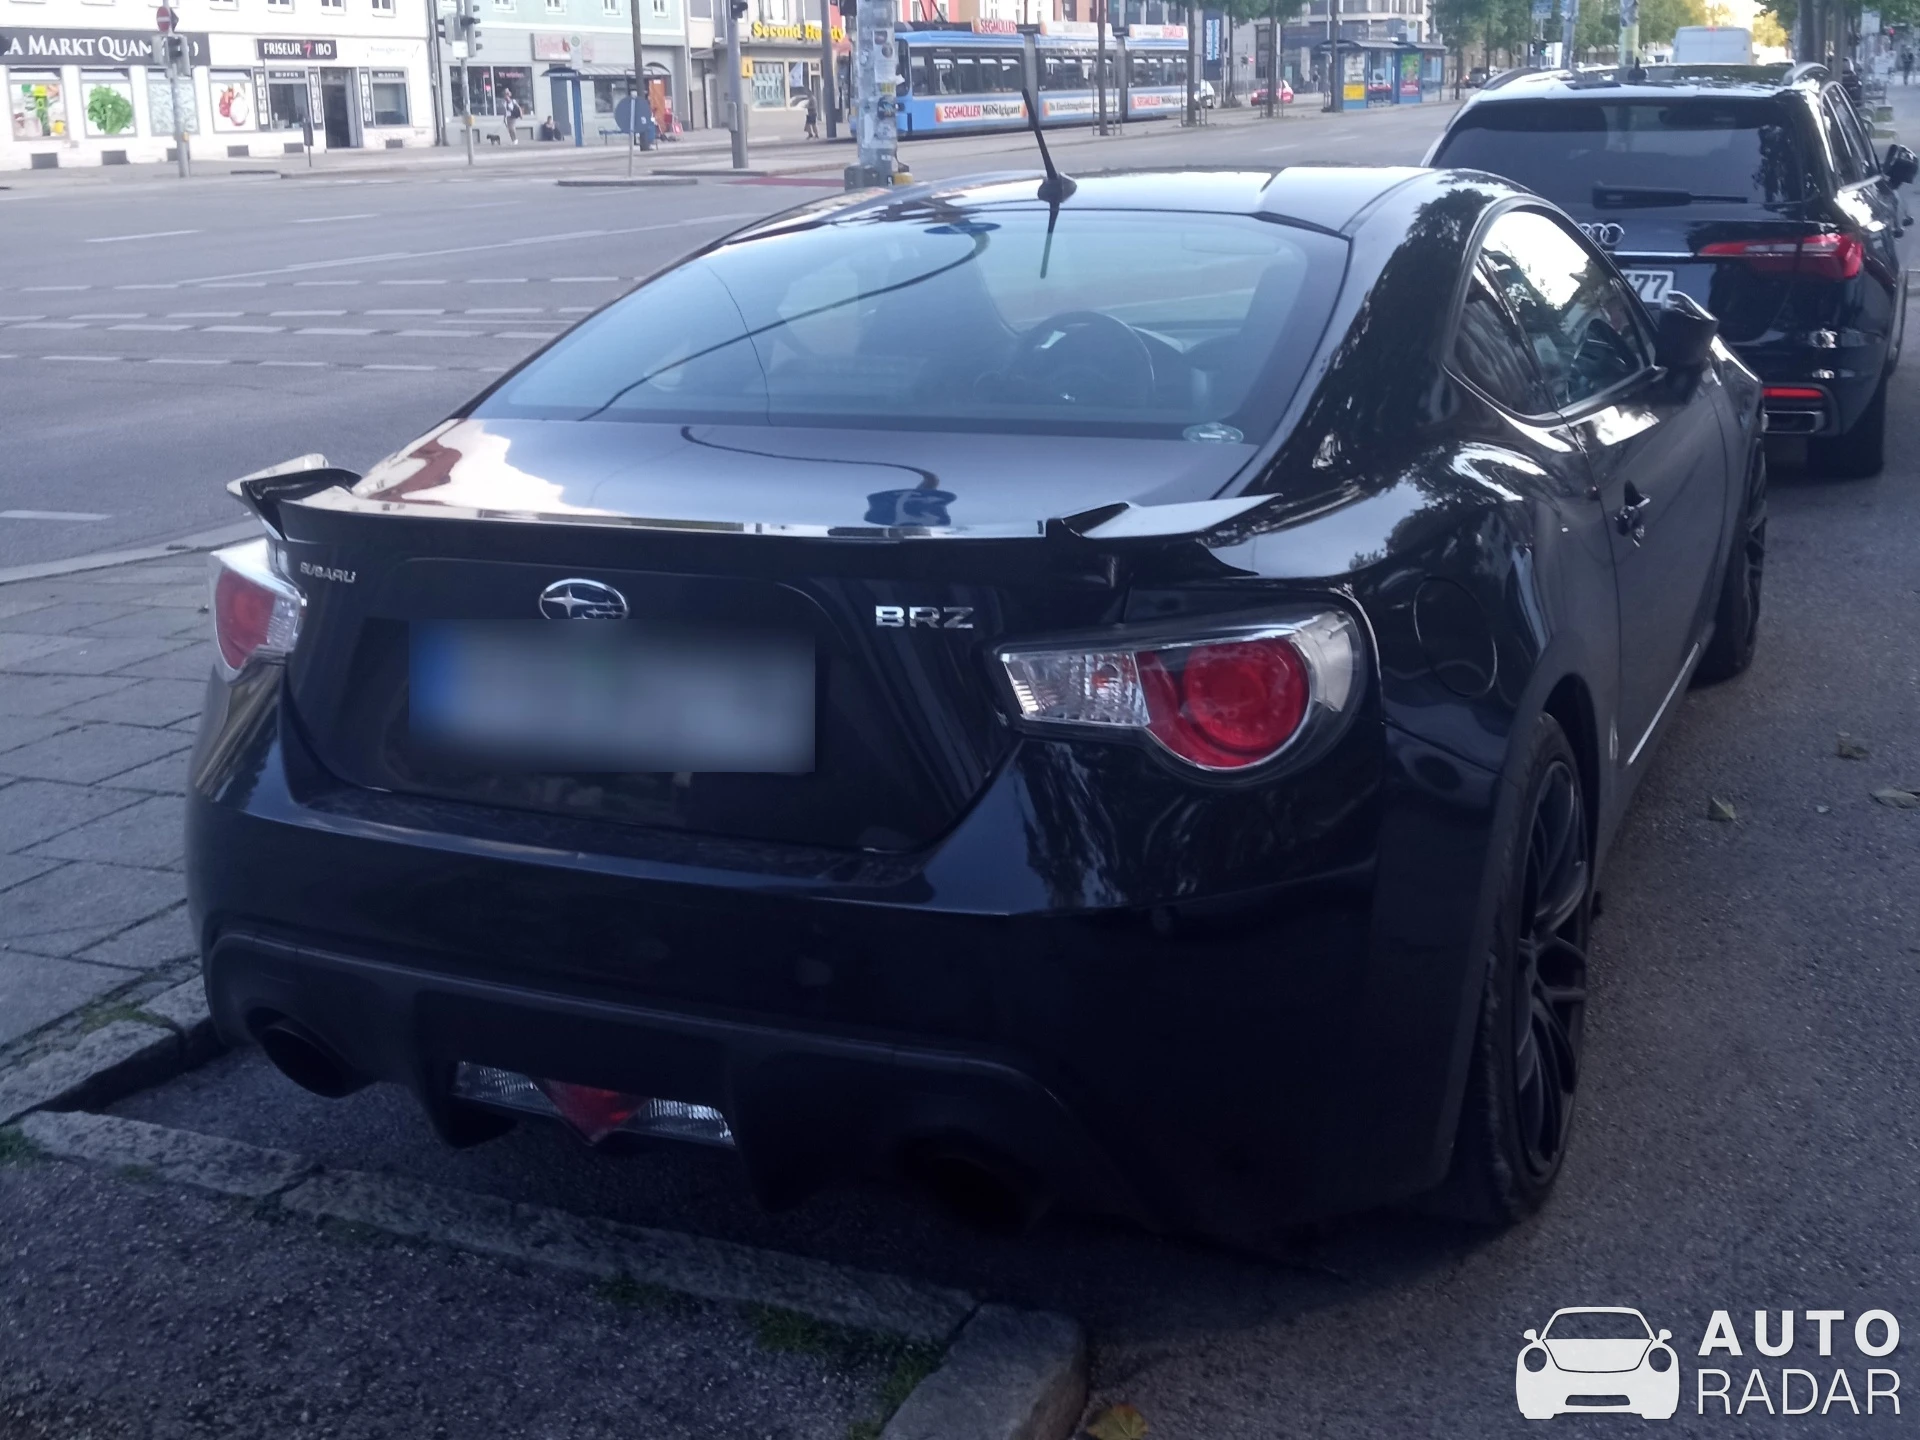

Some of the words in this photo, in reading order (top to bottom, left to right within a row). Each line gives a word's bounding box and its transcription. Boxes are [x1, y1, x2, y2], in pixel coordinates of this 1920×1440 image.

[804, 22, 844, 42] Hady
[28, 35, 95, 57] MARKT
[263, 42, 302, 57] FRISEUR
[315, 42, 332, 56] IBO
[943, 104, 981, 119] SEGMÜLLER
[1624, 273, 1669, 300] 77
[299, 562, 357, 584] SUBARU
[875, 605, 974, 629] BRZ
